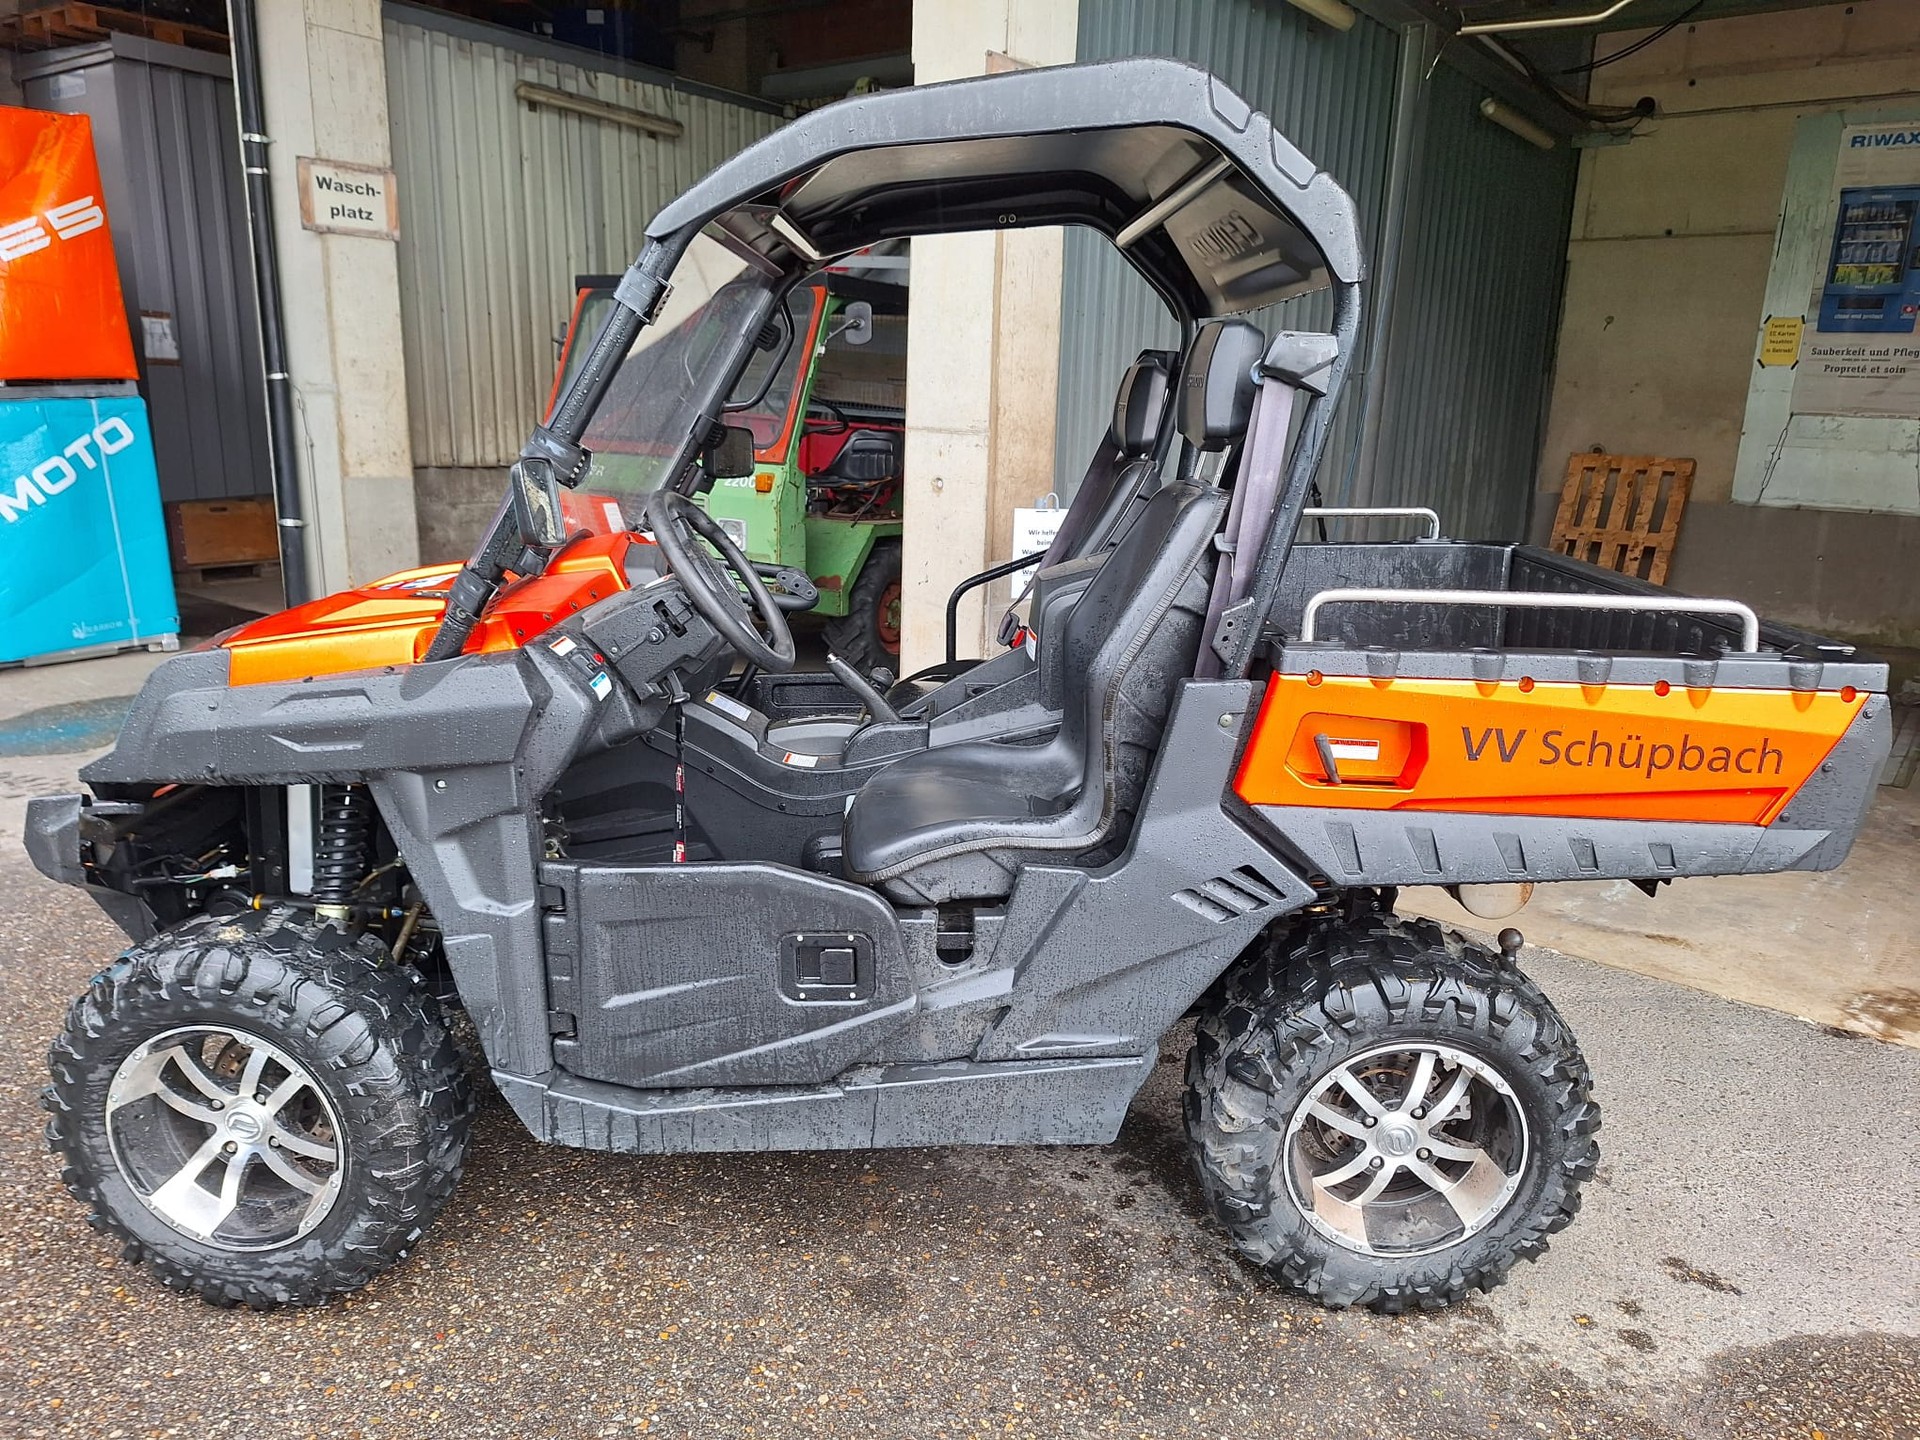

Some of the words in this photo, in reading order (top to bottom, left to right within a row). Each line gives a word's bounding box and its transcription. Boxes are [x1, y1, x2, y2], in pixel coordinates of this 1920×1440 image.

[1851, 131, 1920, 148] RIWAX
[316, 175, 381, 197] Wasch-
[330, 204, 374, 222] platz
[1811, 347, 1865, 357] Sauberkeit
[1869, 348, 1889, 357] und
[1823, 364, 1867, 375] Propreté
[1870, 365, 1880, 374] et
[1883, 364, 1906, 374] soin
[0, 417, 134, 523] MOTO
[1539, 730, 1784, 779] Schüpbach
